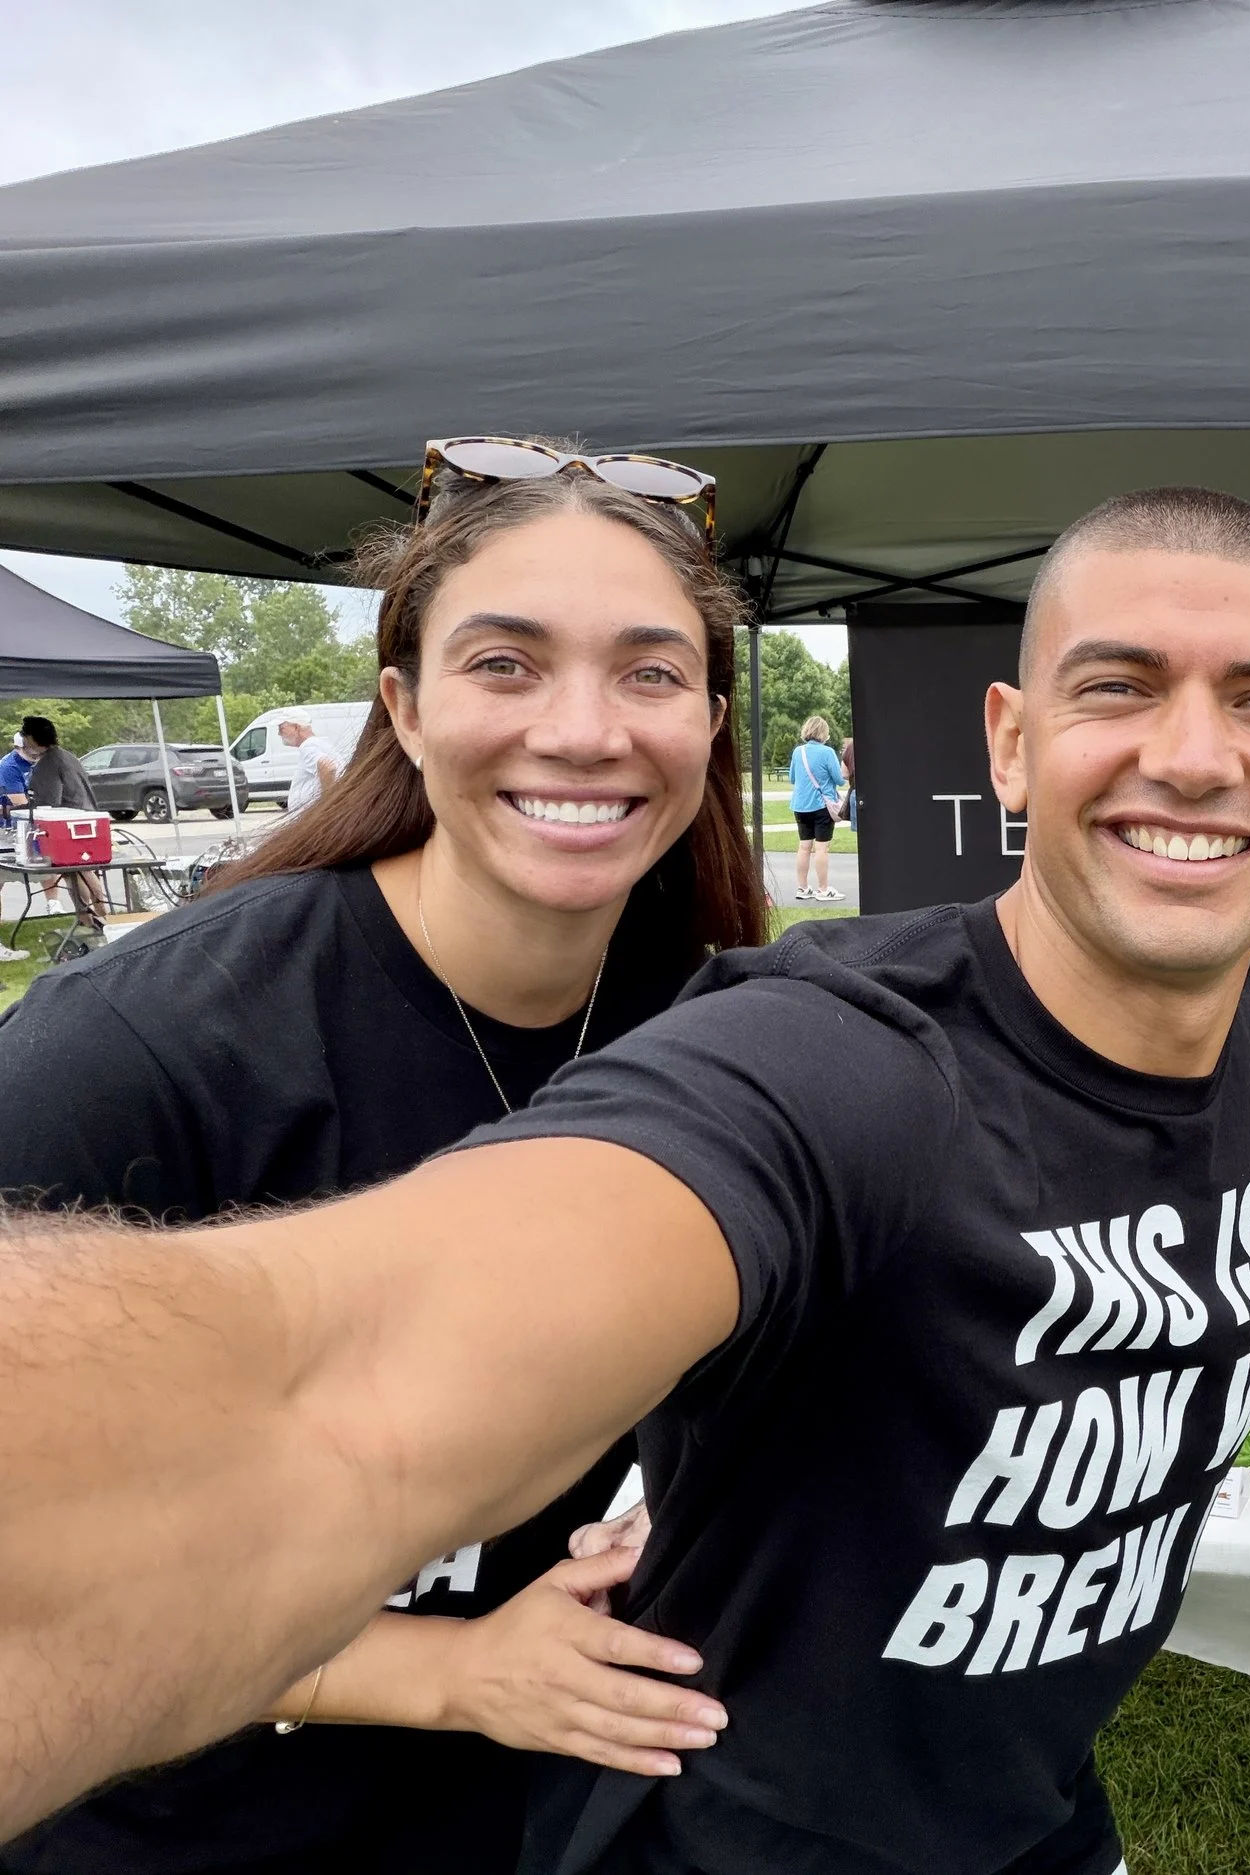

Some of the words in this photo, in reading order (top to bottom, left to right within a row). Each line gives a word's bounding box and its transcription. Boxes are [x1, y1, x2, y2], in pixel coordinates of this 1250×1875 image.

[1014, 1203, 1209, 1367] THIS
[944, 1366, 1204, 1530] HOW
[880, 1502, 1192, 1676] BREW
